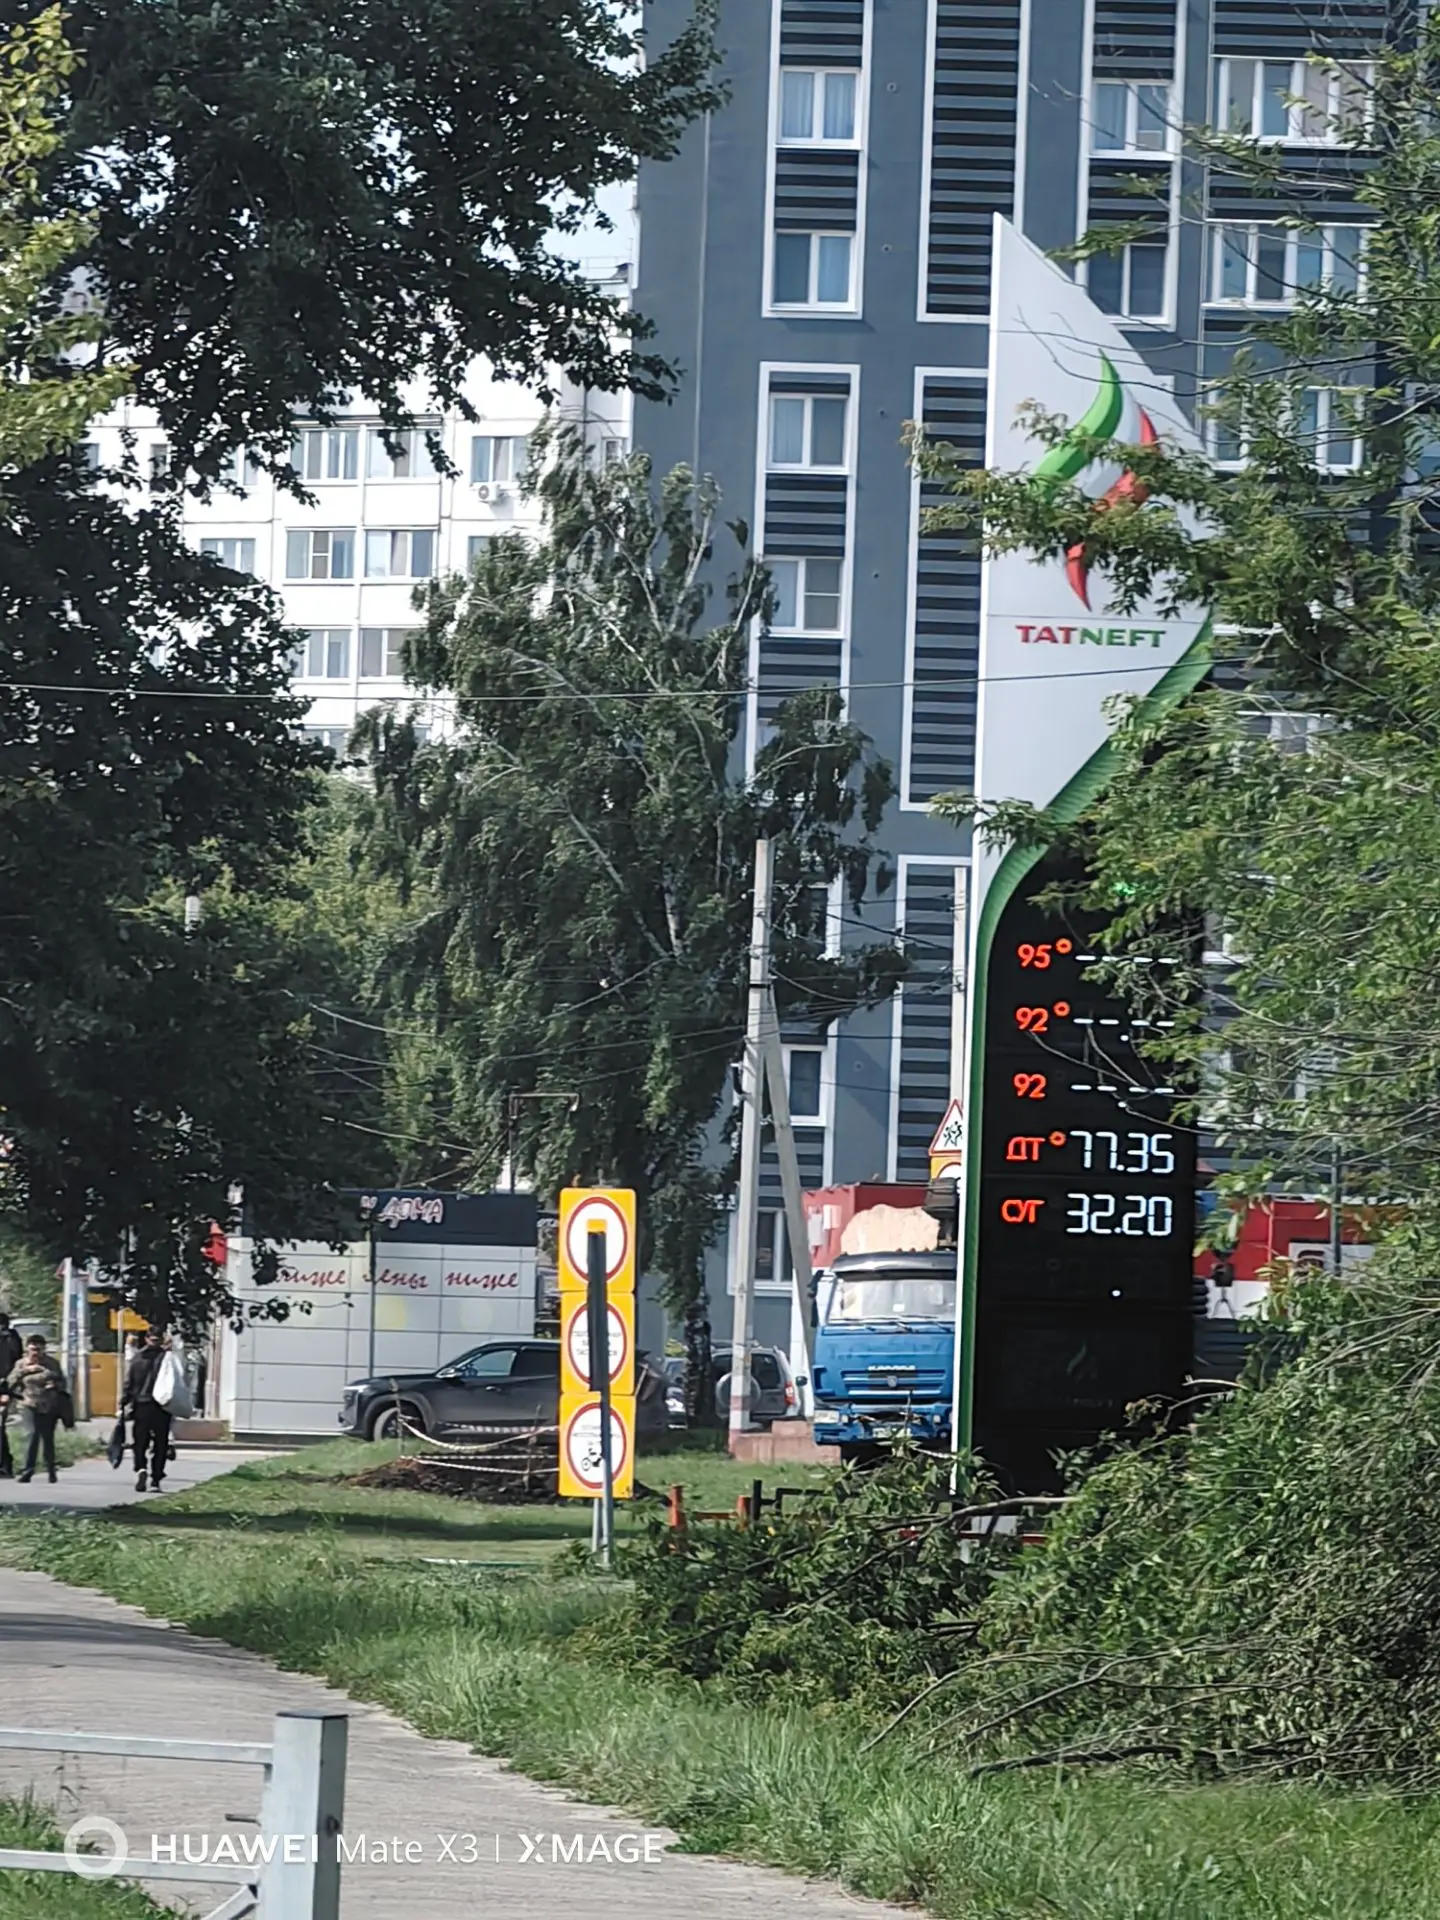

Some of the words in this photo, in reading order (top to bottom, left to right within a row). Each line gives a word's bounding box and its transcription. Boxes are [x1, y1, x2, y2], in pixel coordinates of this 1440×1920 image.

[1015, 624, 1167, 648] TATNEFT
[1013, 1073, 1047, 1098] 92
[1070, 1130, 1175, 1174] 77.35
[1066, 1193, 1173, 1236] 32.20
[445, 1271, 520, 1291] ниже
